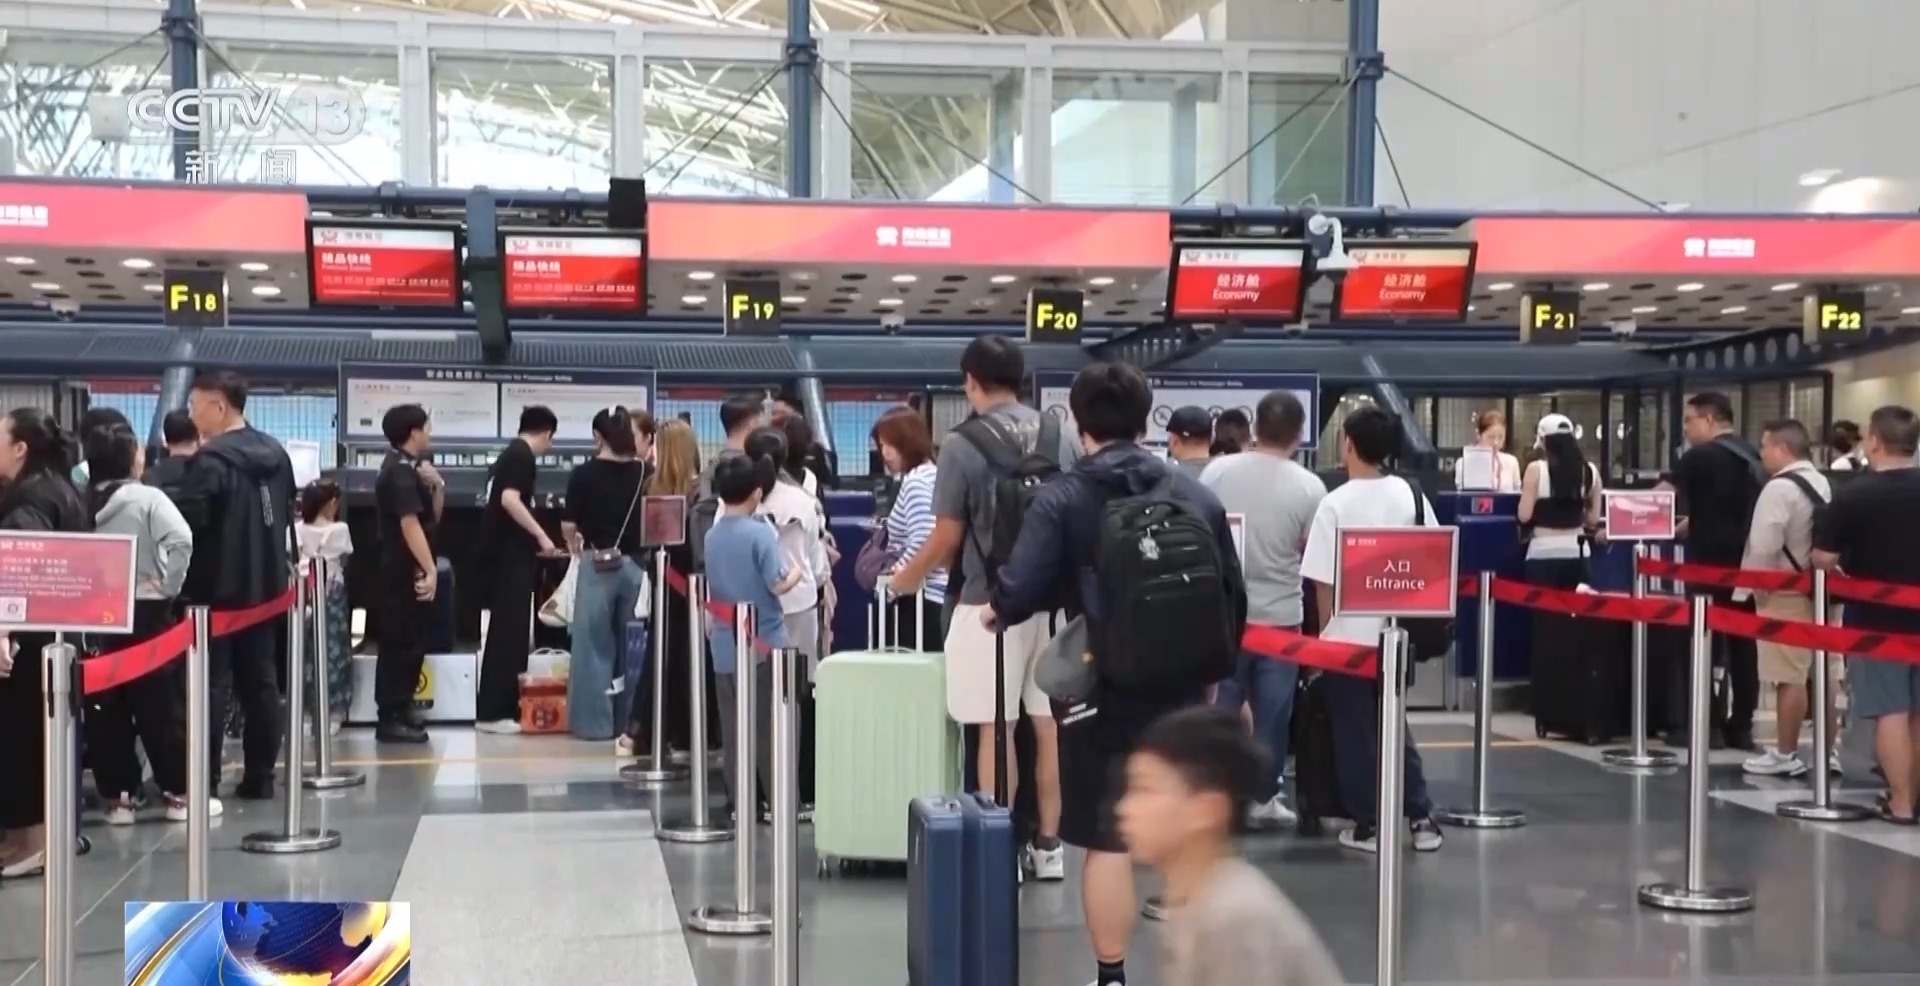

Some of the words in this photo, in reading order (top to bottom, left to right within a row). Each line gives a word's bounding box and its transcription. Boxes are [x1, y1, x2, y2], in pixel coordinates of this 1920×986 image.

[1217, 273, 1260, 288] 经济舱
[1384, 273, 1427, 288] 经济舱
[171, 285, 216, 311] F18
[1212, 287, 1260, 303] Economy
[1379, 287, 1427, 302] Economy
[733, 295, 773, 319] F19
[1037, 304, 1077, 329] F20
[1536, 305, 1574, 329] F21
[1822, 305, 1861, 329] F22
[1383, 559, 1411, 573] 入口
[1365, 575, 1425, 590] Entrance
